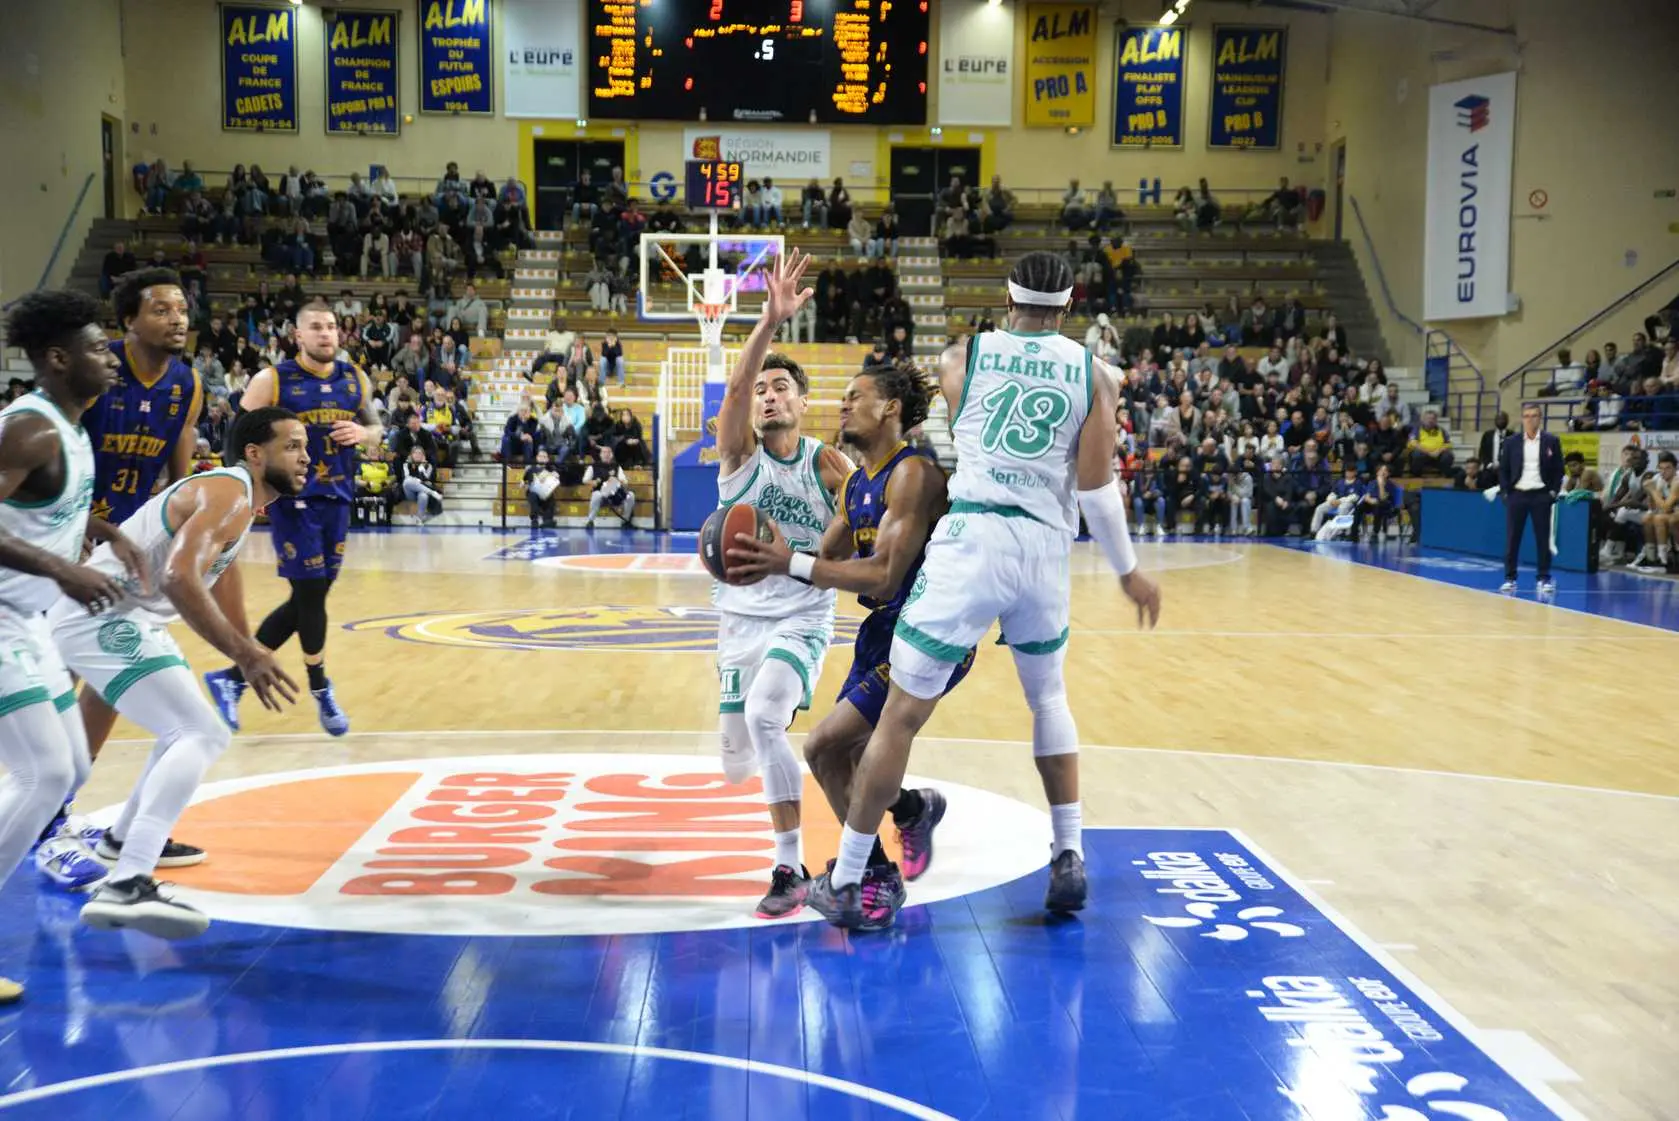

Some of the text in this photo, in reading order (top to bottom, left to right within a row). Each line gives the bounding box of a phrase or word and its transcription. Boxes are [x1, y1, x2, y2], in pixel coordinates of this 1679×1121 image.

[424, 0, 485, 30] ALM
[1032, 8, 1091, 42] ALM
[228, 11, 289, 47] ALM
[330, 16, 391, 51] ALM
[241, 53, 278, 65] COUPE
[448, 49, 464, 60] DU
[1120, 30, 1181, 66] ALM
[1218, 32, 1280, 66] ALM
[252, 65, 268, 75] DE
[334, 57, 390, 68] CHAMPION
[439, 61, 474, 71] FUTUR
[238, 77, 282, 88] FRANCE
[341, 80, 384, 92] FRANCE
[355, 70, 369, 79] DE
[431, 73, 482, 97] ESPOIRS
[1123, 72, 1177, 84] FINALISTE
[1034, 71, 1088, 102] PRO A
[1136, 84, 1163, 94] PLAY
[235, 93, 283, 115] CADETS
[1135, 96, 1163, 106] OFFS
[1234, 96, 1257, 107] CUP
[1128, 112, 1155, 132] PRO
[1224, 112, 1250, 133] PRO
[726, 137, 774, 149] RÉGION
[726, 150, 822, 163] NORMANDIE
[649, 171, 677, 201] G
[705, 181, 730, 207] 15
[1139, 177, 1161, 206] H
[1457, 143, 1480, 303] EUROVIA
[978, 353, 1081, 384] CLARK II
[980, 379, 1072, 460] 13
[111, 468, 140, 494] 31
[948, 519, 966, 537] 13
[338, 772, 576, 896] BURGER
[529, 772, 777, 897] KING
[1132, 851, 1242, 902] dalkia
